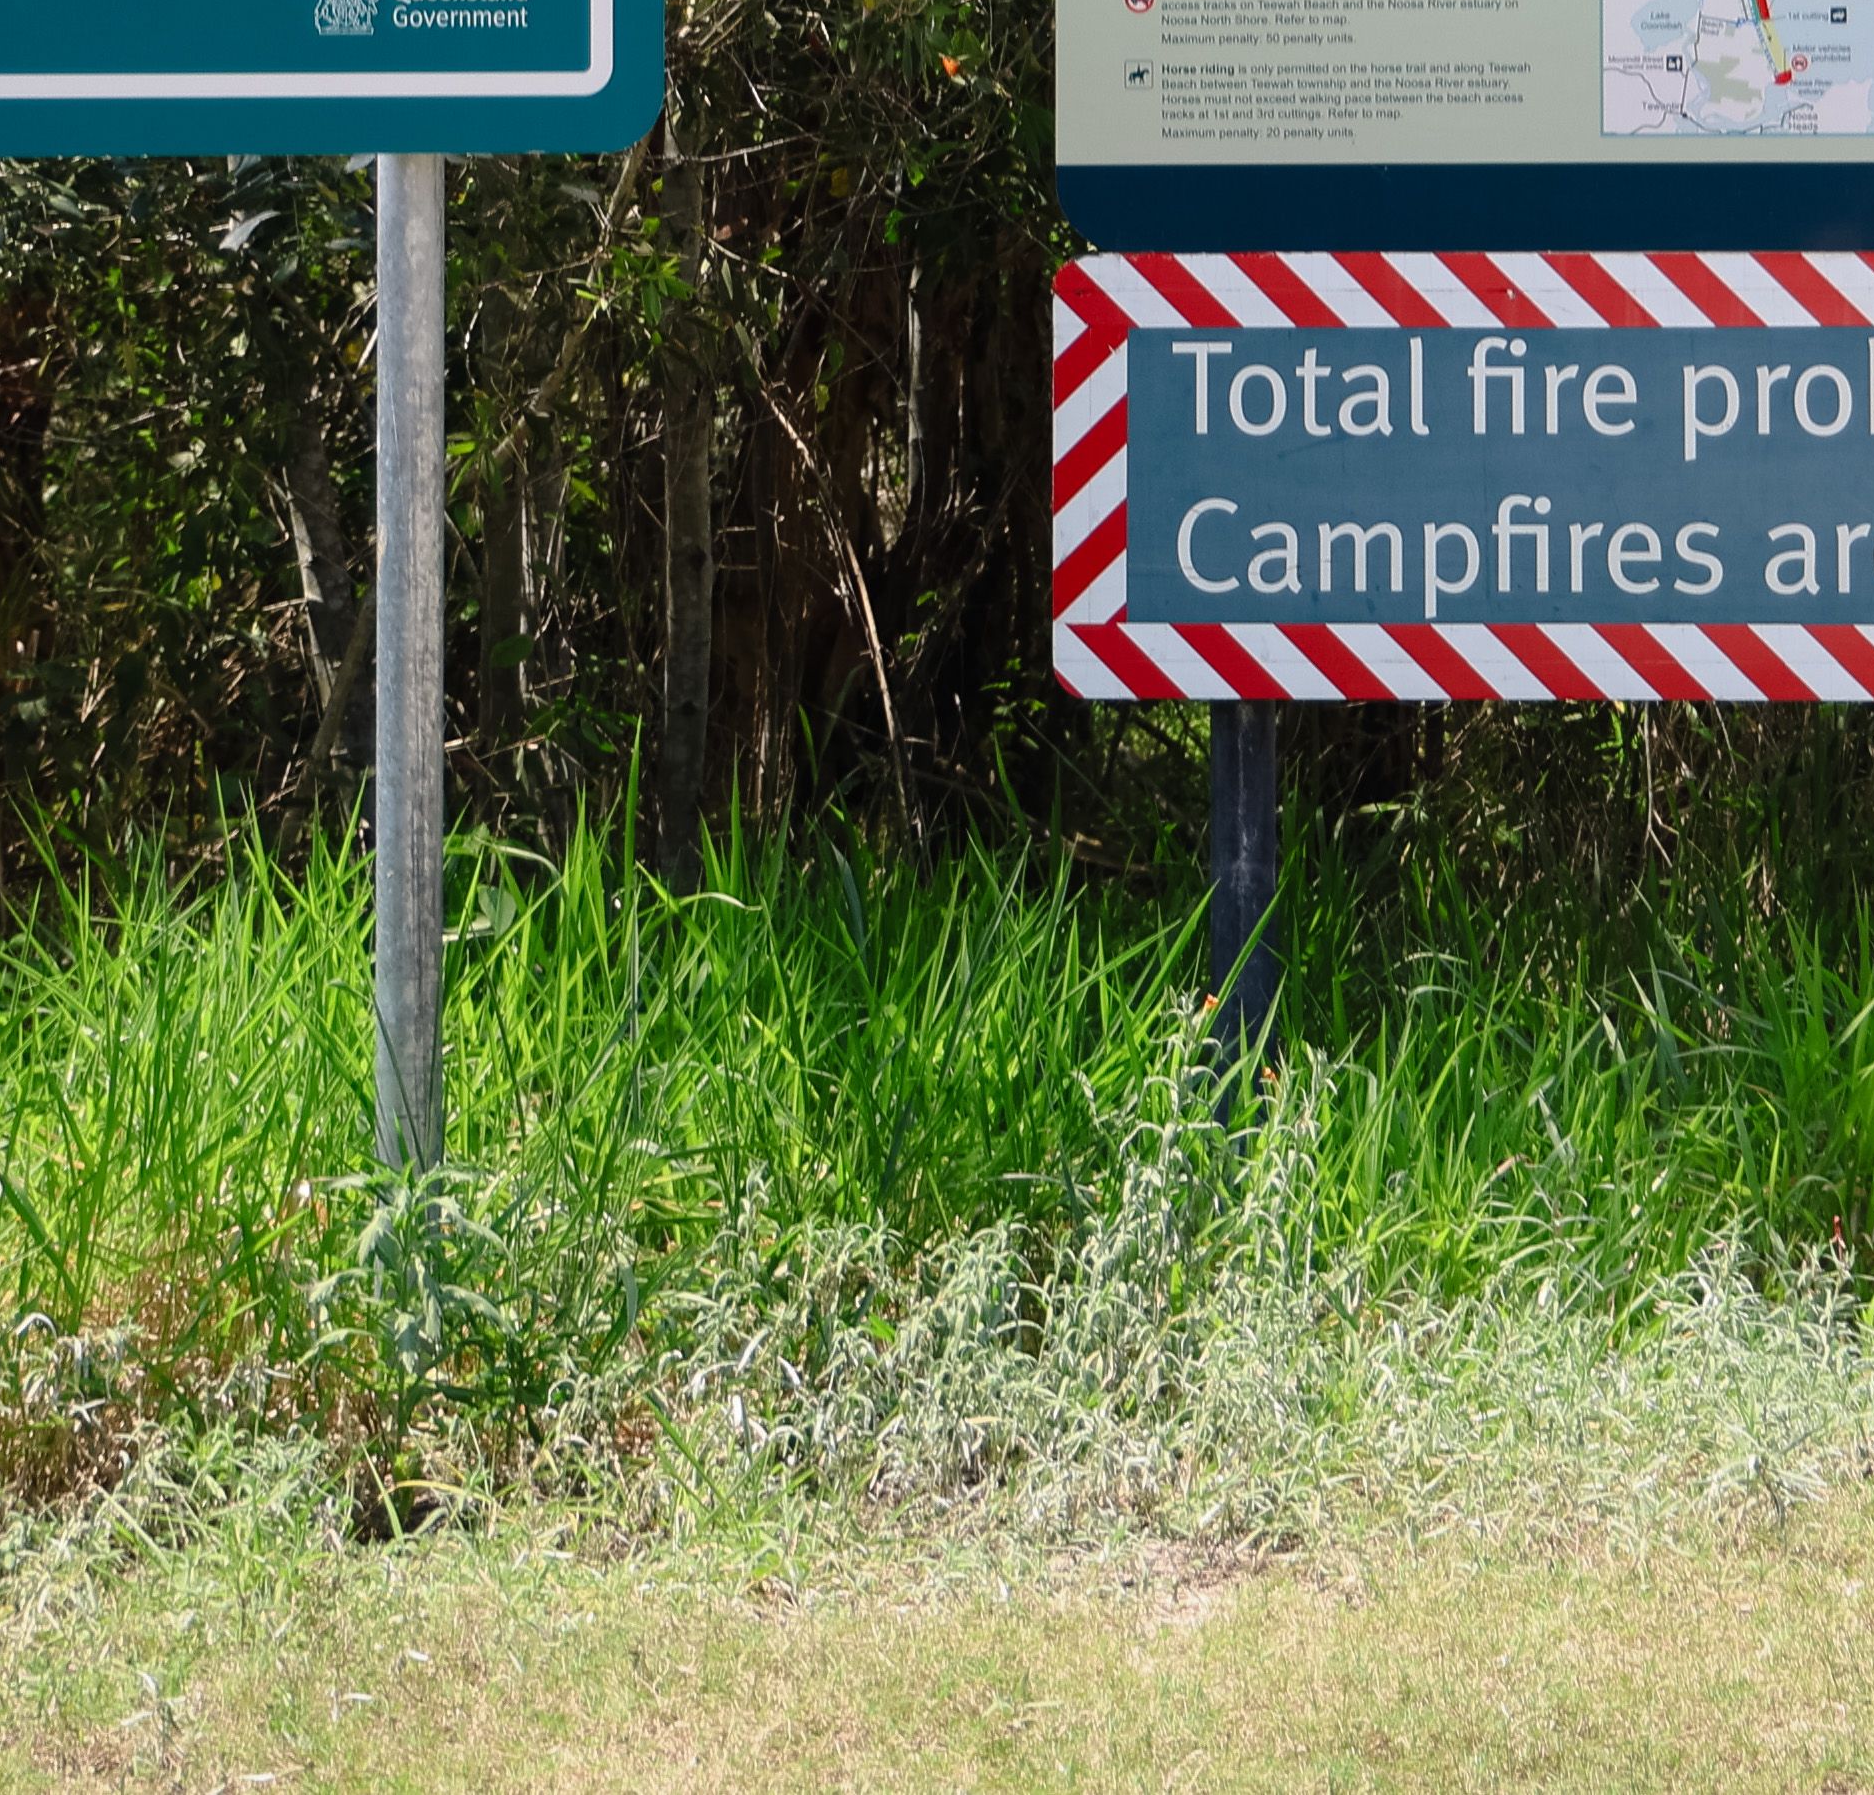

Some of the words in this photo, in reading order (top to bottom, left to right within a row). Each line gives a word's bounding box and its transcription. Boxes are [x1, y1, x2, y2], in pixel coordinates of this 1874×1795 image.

[393, 5, 526, 27] Government
[1172, 338, 1432, 437] Total
[1468, 338, 1638, 436] fire
[1177, 497, 1722, 619] Campfires
